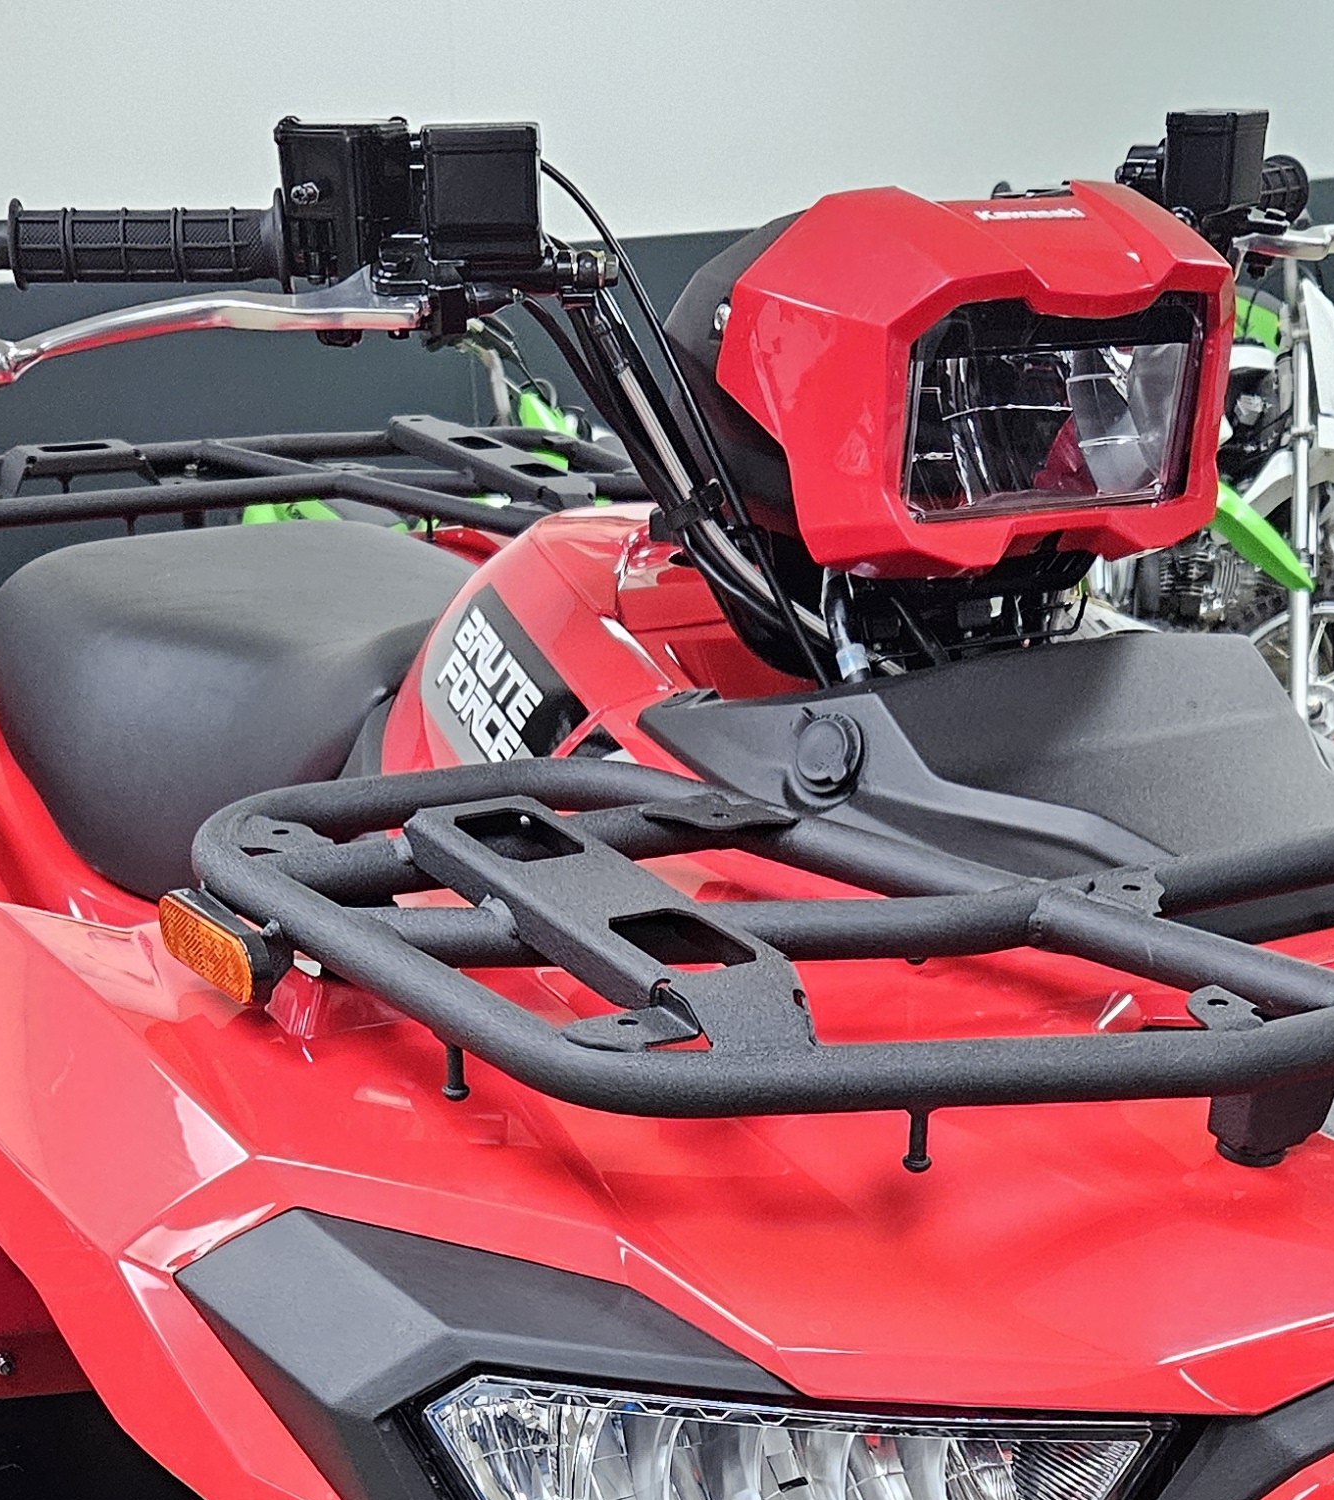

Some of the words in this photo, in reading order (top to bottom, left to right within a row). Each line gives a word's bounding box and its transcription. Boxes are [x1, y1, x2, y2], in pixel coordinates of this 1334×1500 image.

[973, 208, 1086, 221] Kawasaki
[435, 648, 523, 764] FORCE
[453, 605, 544, 732] BRUTE
